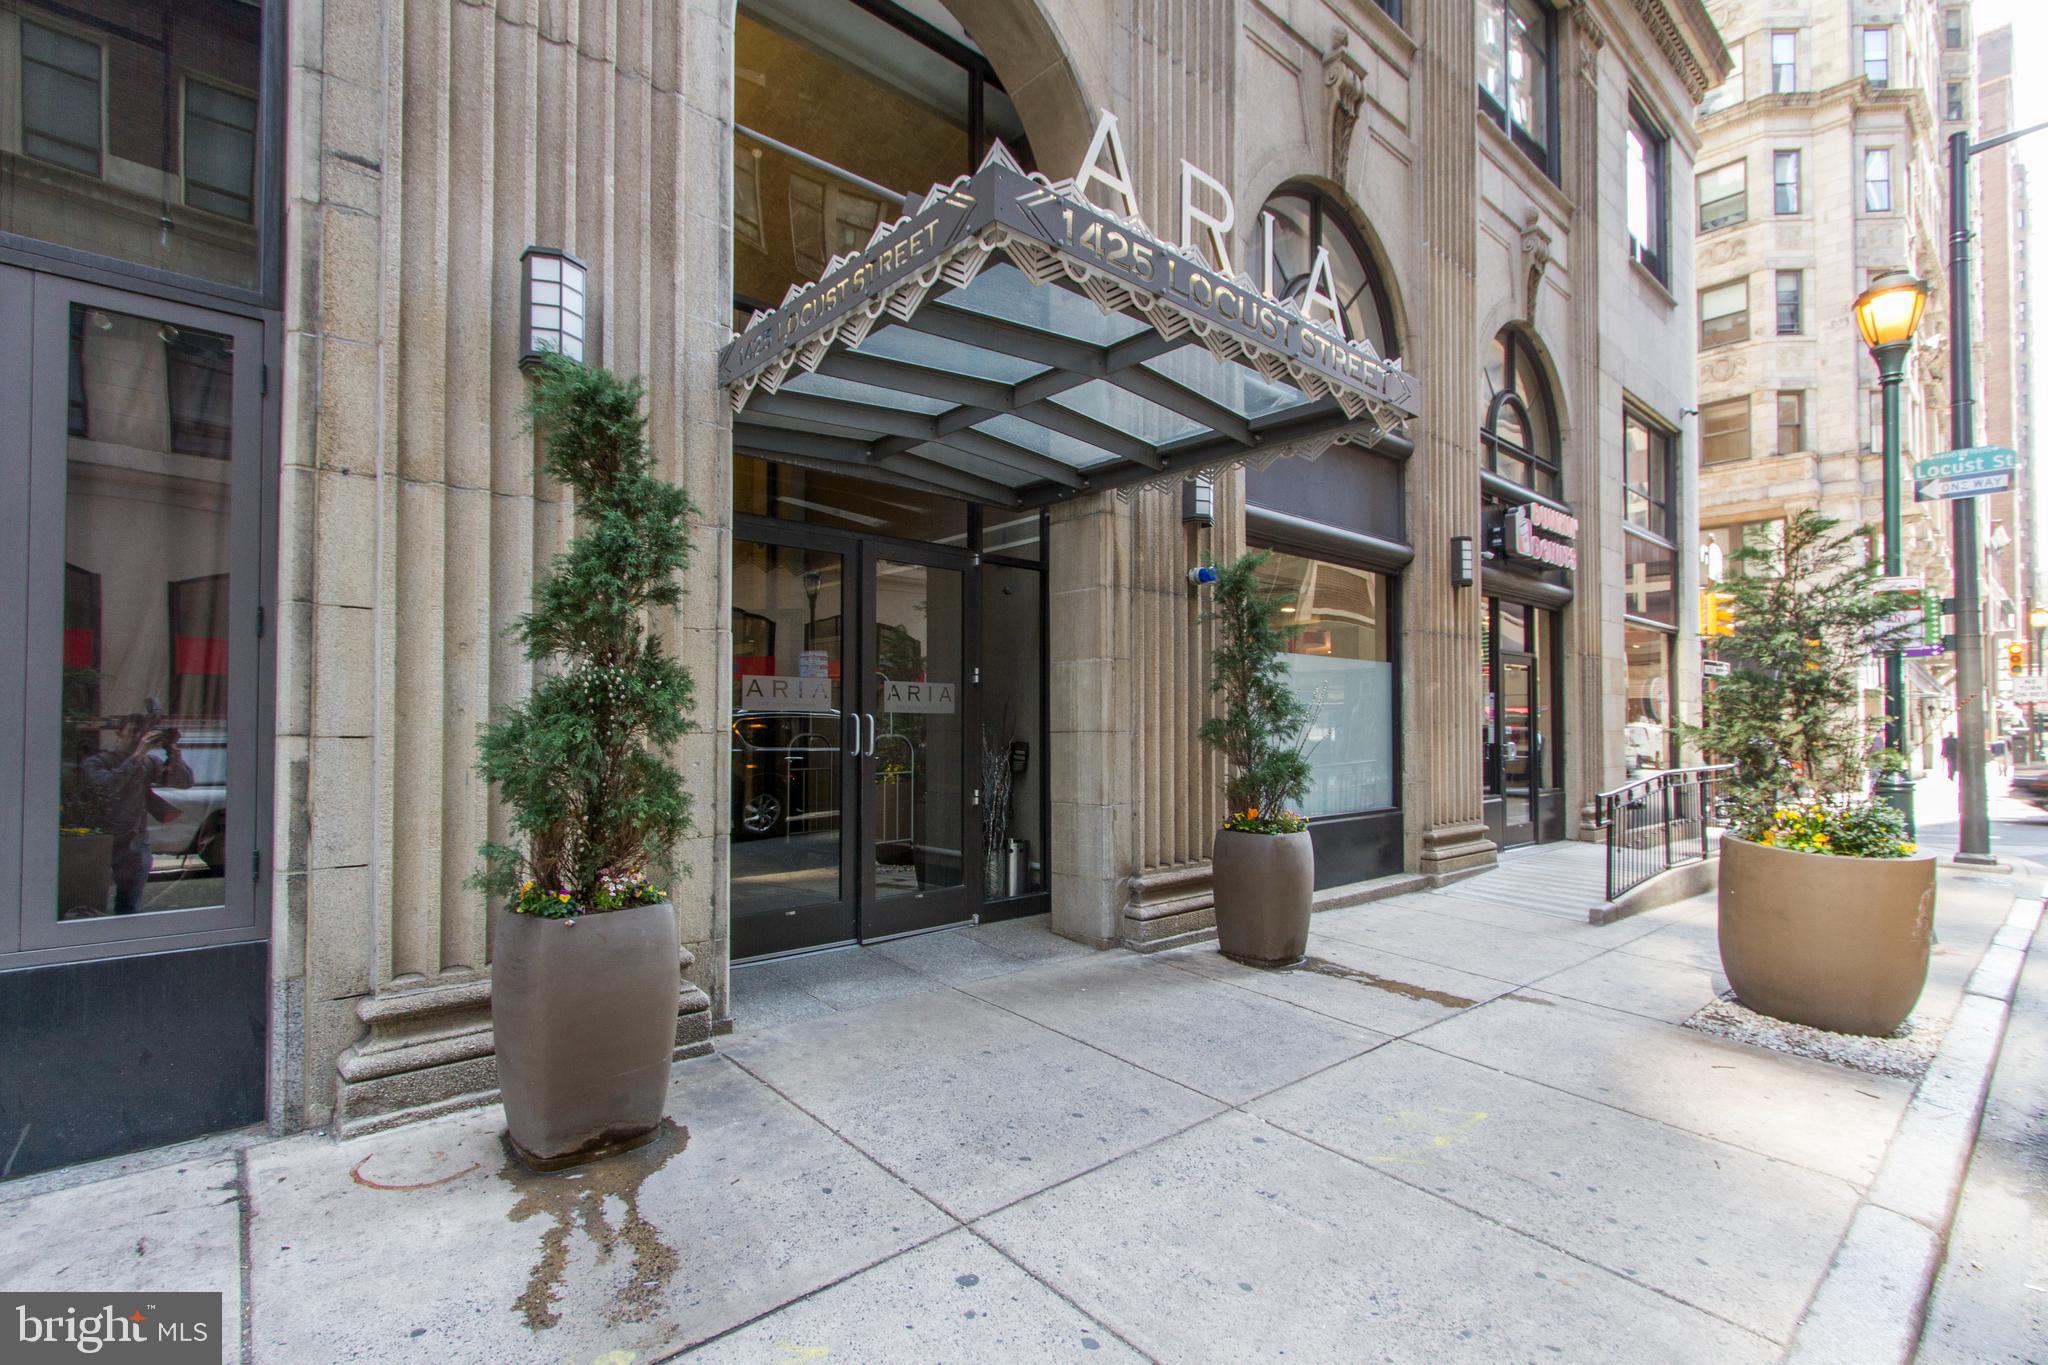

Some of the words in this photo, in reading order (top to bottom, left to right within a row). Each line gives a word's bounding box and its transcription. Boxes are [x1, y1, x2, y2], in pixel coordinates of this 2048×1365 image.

[1076, 107, 1347, 338] ARIA
[778, 278, 849, 343] LOCUST
[852, 218, 940, 295] STREET
[1062, 208, 1156, 282] 1425
[1168, 259, 1292, 348] LOCUST
[1300, 326, 1392, 395] STREET
[1915, 456, 1985, 479] Locust
[1993, 453, 2014, 469] St
[1941, 481, 1969, 492] ONE
[1973, 476, 2003, 488] WAY
[746, 678, 828, 700] ARIA
[887, 684, 953, 703] ARIA
